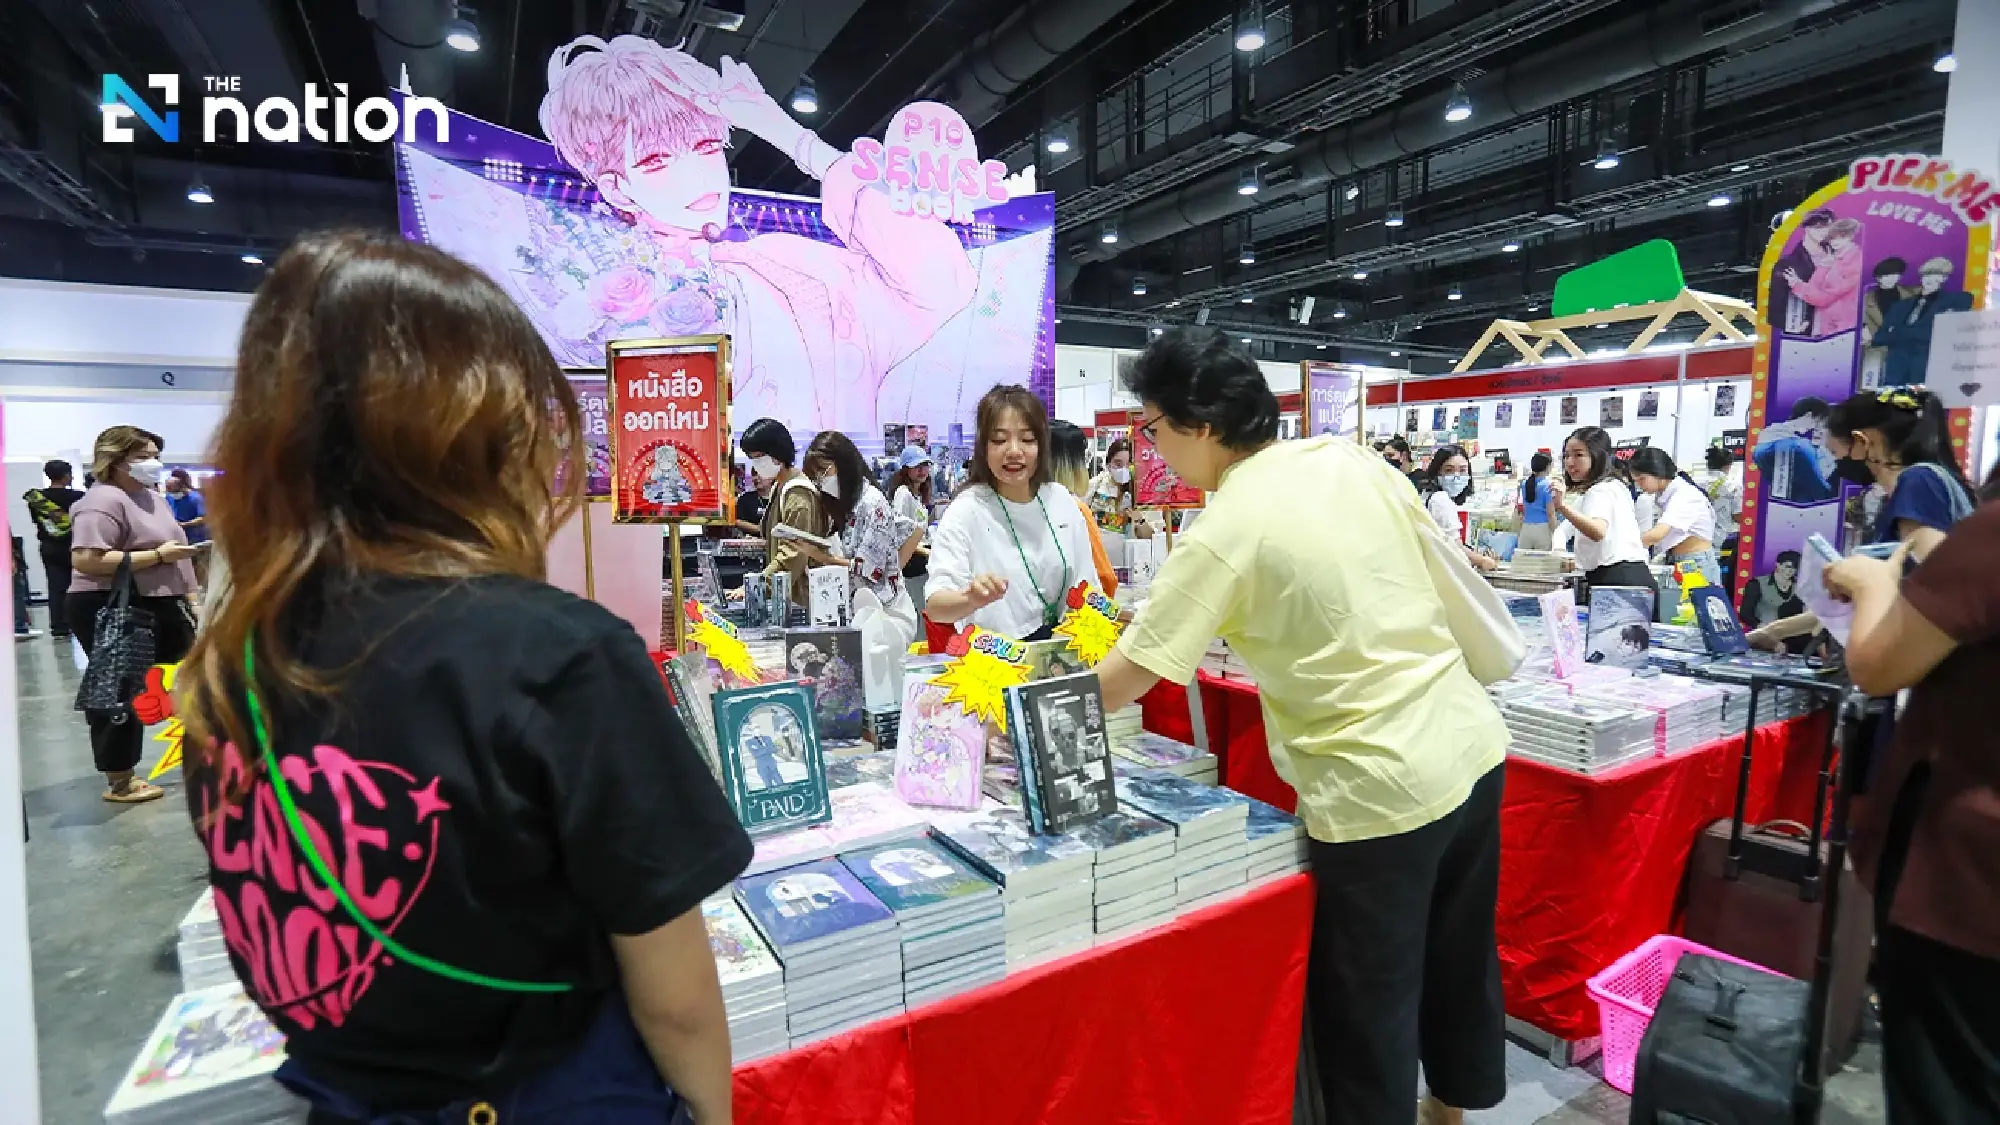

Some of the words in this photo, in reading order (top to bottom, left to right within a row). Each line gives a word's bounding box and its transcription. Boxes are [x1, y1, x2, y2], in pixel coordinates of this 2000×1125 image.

[852, 139, 1009, 202] SENSE
[1851, 158, 1949, 192] PICK
[1866, 200, 1923, 223] LOVE
[162, 371, 175, 387] Q
[628, 369, 703, 399] หนังสือ
[623, 402, 710, 431] ออกใหม่
[759, 795, 805, 820] PAID
